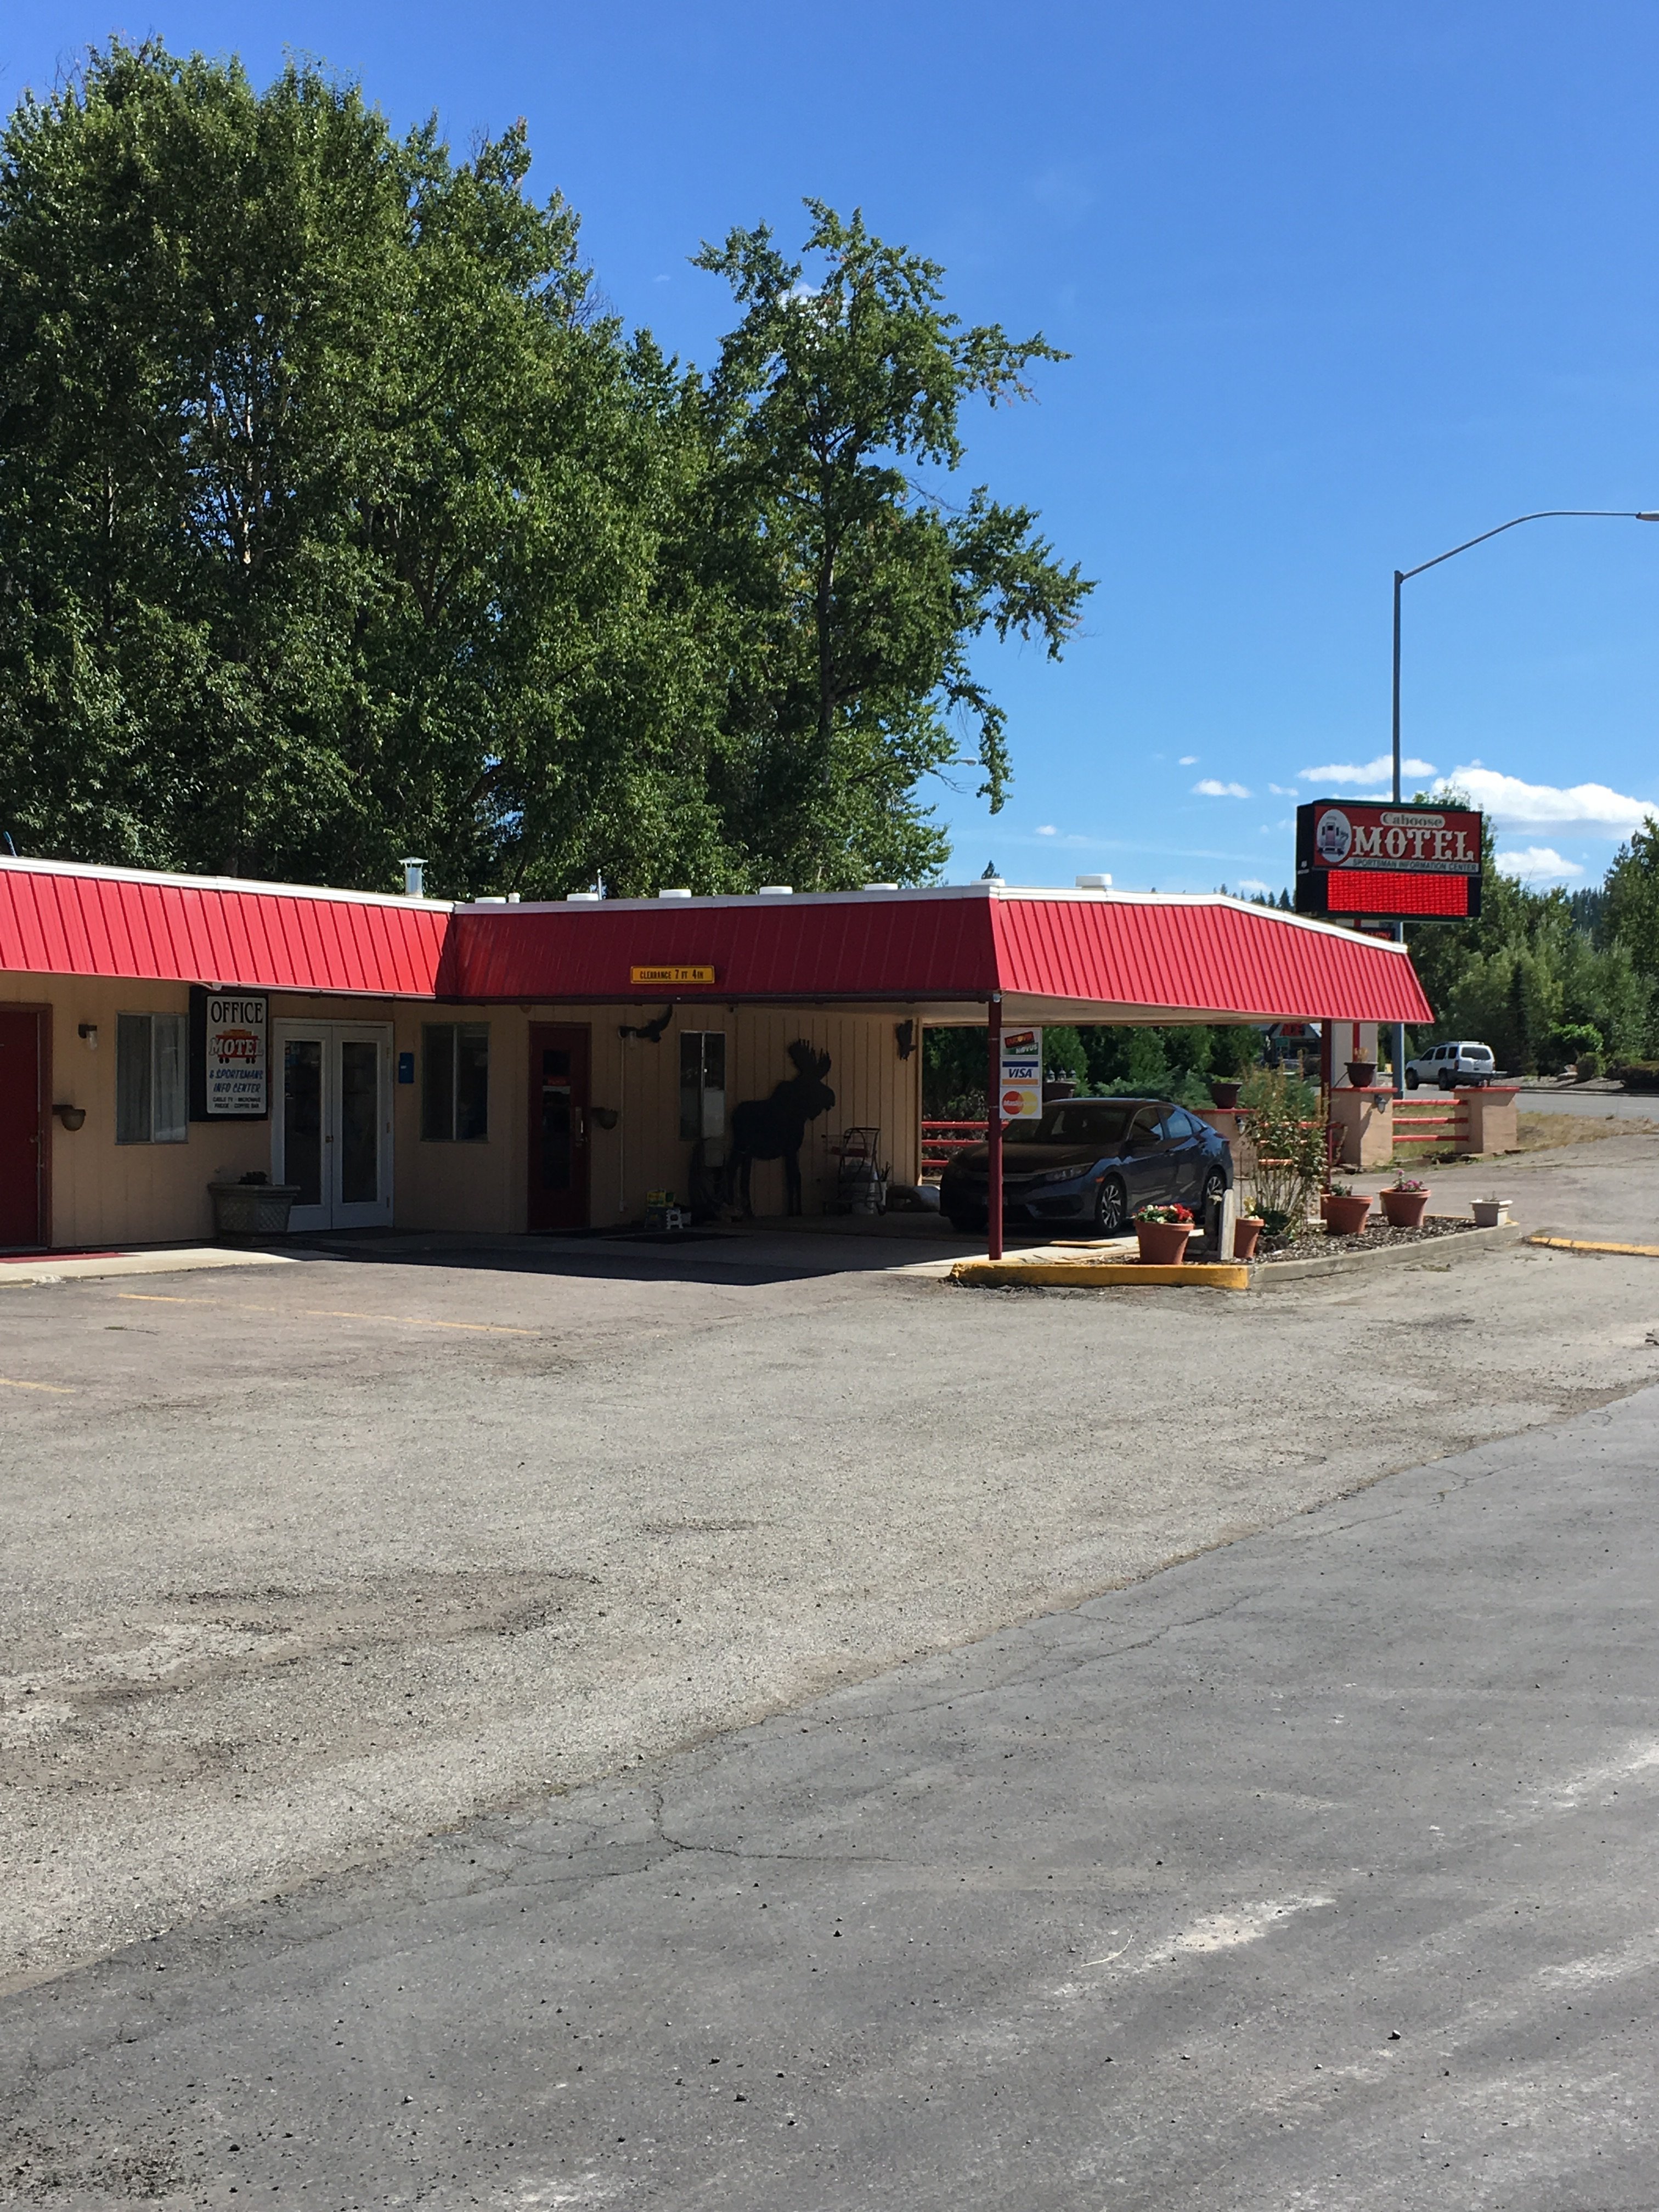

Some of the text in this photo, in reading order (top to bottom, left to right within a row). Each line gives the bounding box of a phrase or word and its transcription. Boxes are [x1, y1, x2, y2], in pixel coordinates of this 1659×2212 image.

[1352, 826, 1474, 861] MOTEL
[1353, 859, 1477, 871] SPORTSMAN INFORMATION CENTER
[640, 970, 672, 979] CLEARANCE
[675, 969, 679, 979] 7
[211, 1001, 263, 1024] OFFICE
[208, 1037, 264, 1057] MOTEL
[1008, 1068, 1032, 1078] VISA
[213, 1082, 261, 1093] INFO CENTER
